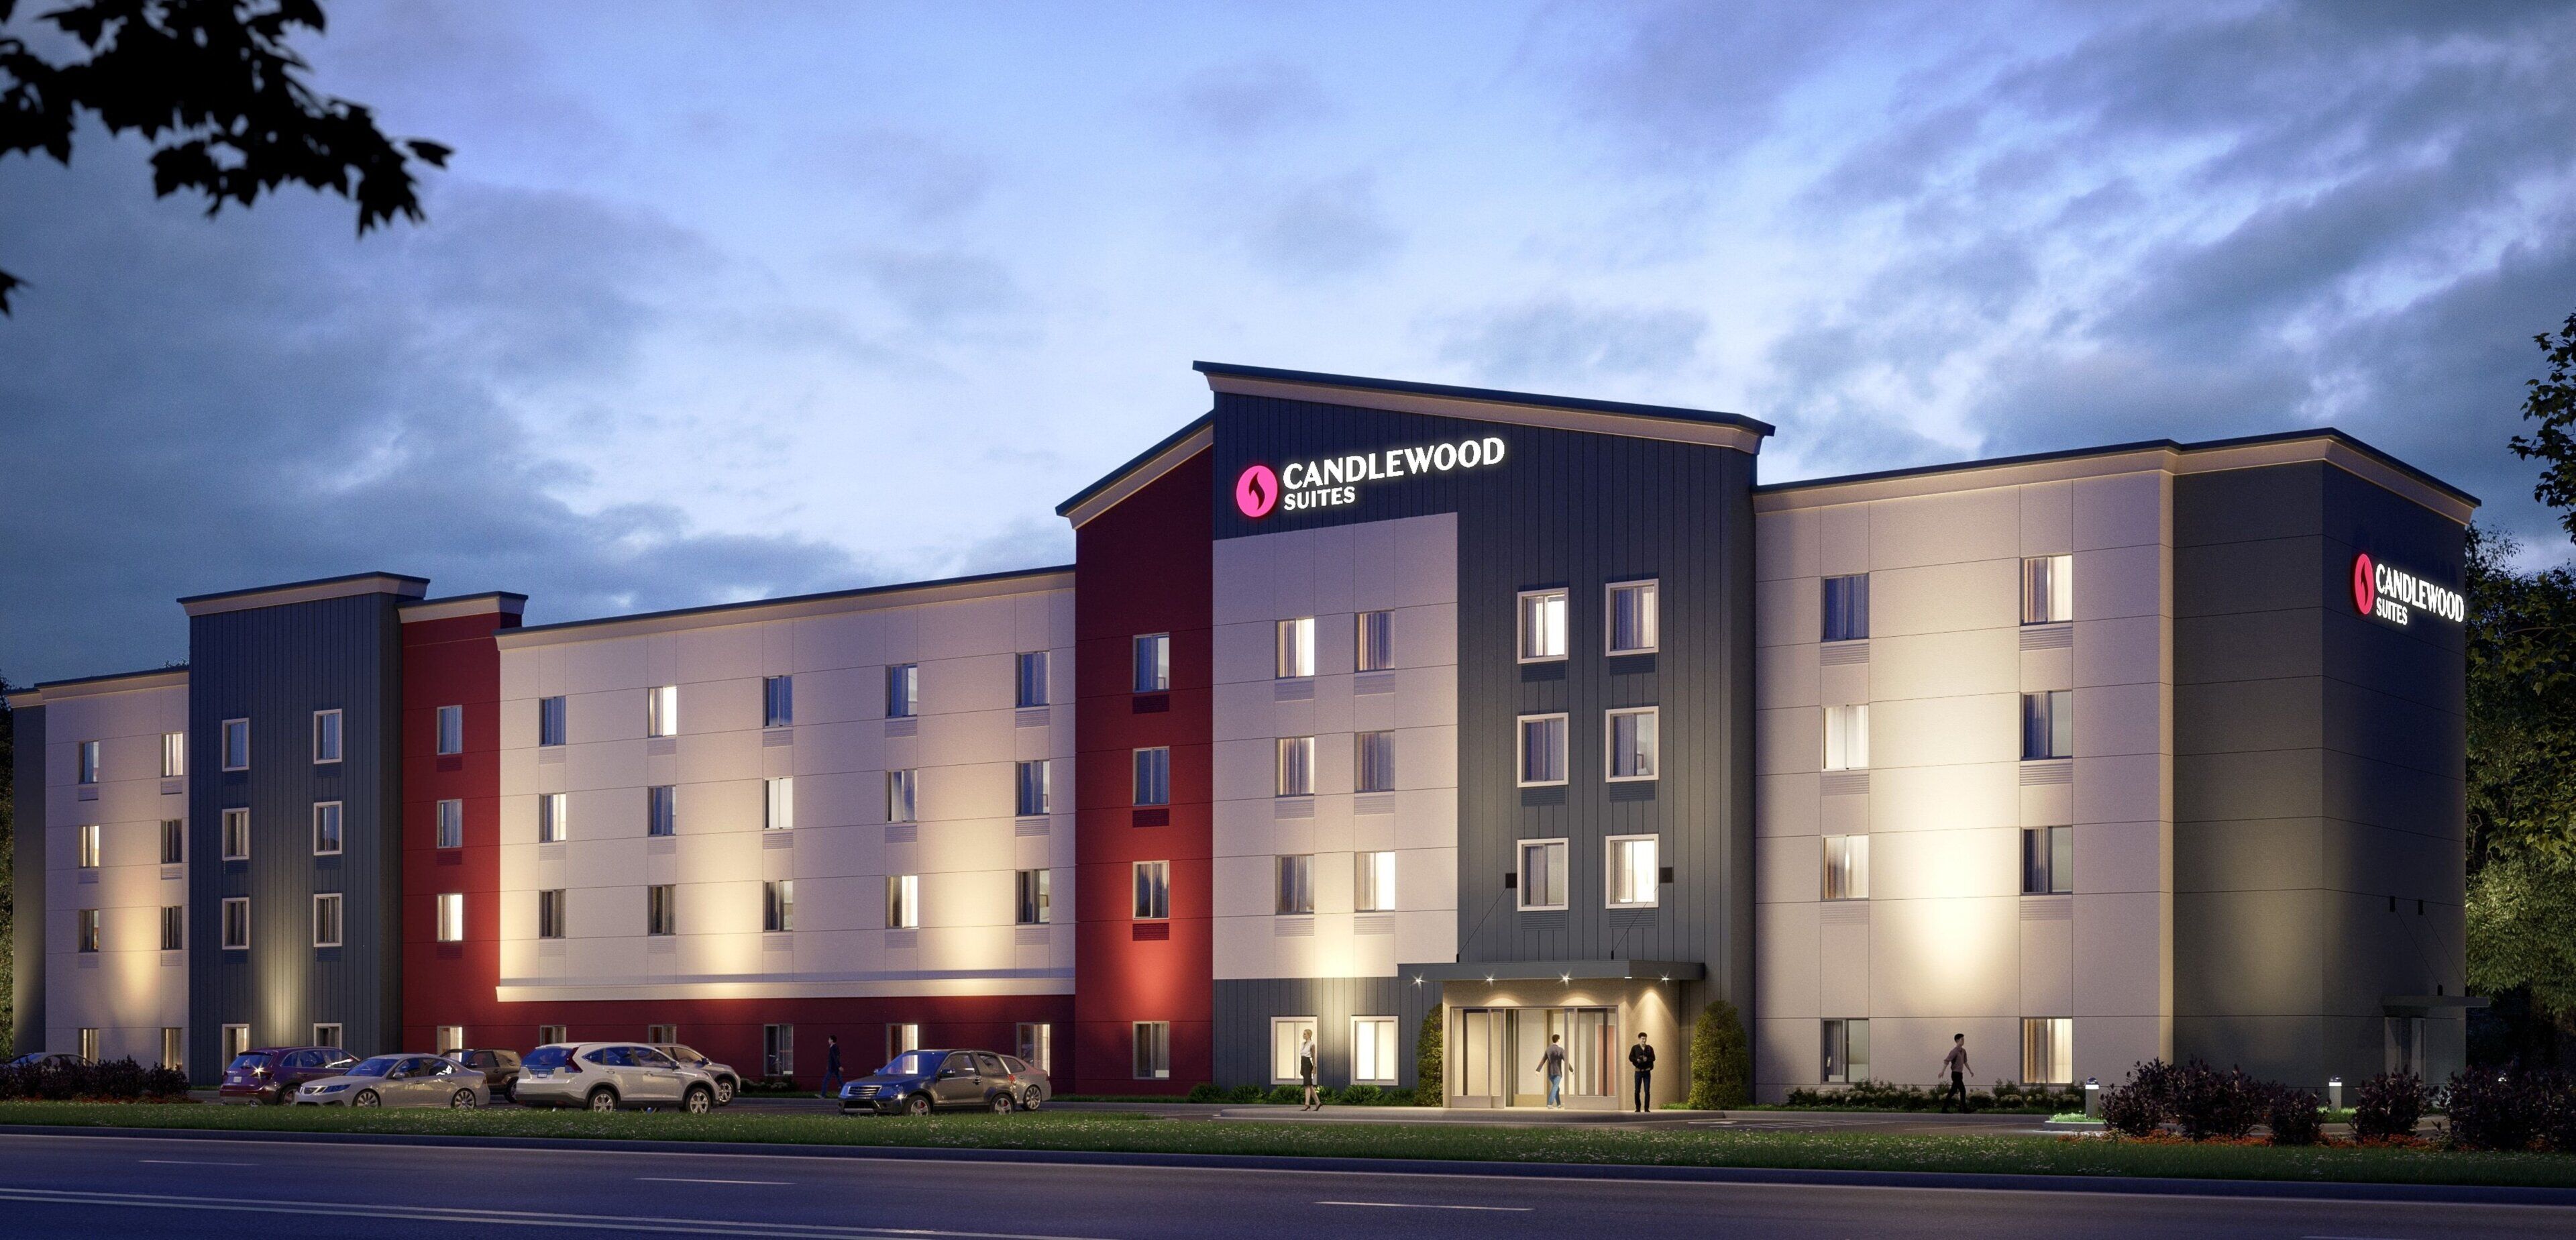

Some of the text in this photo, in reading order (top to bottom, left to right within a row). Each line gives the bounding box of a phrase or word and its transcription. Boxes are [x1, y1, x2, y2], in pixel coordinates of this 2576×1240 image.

[1283, 437, 1505, 489] CANDLEWOOD
[1283, 486, 1355, 510] SUITES
[2375, 564, 2464, 622] CANDLEWOOD
[2376, 597, 2408, 625] SUITES
